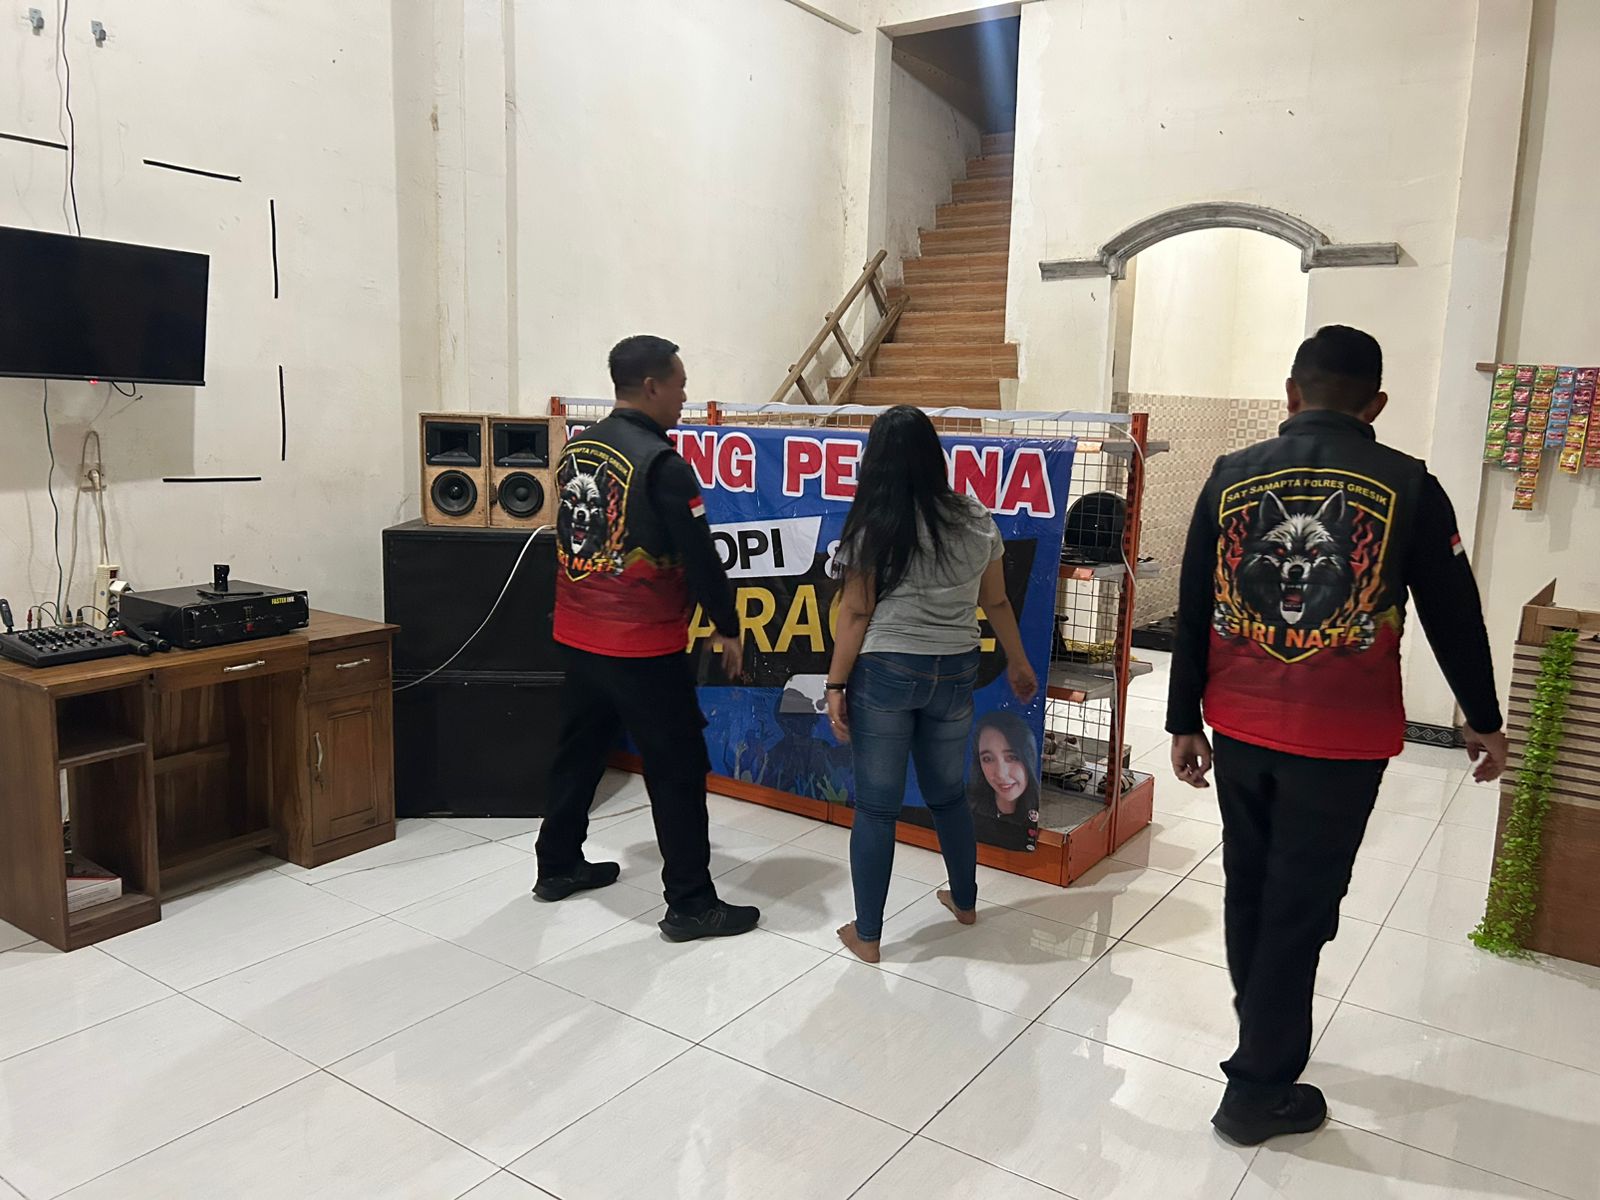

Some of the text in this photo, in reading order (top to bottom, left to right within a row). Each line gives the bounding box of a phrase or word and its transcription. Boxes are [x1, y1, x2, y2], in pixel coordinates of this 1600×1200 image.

[783, 436, 1055, 518] PENA
[1226, 479, 1388, 506] SAT SAMAPTA POLRES GRESIK
[711, 528, 785, 572] OPI
